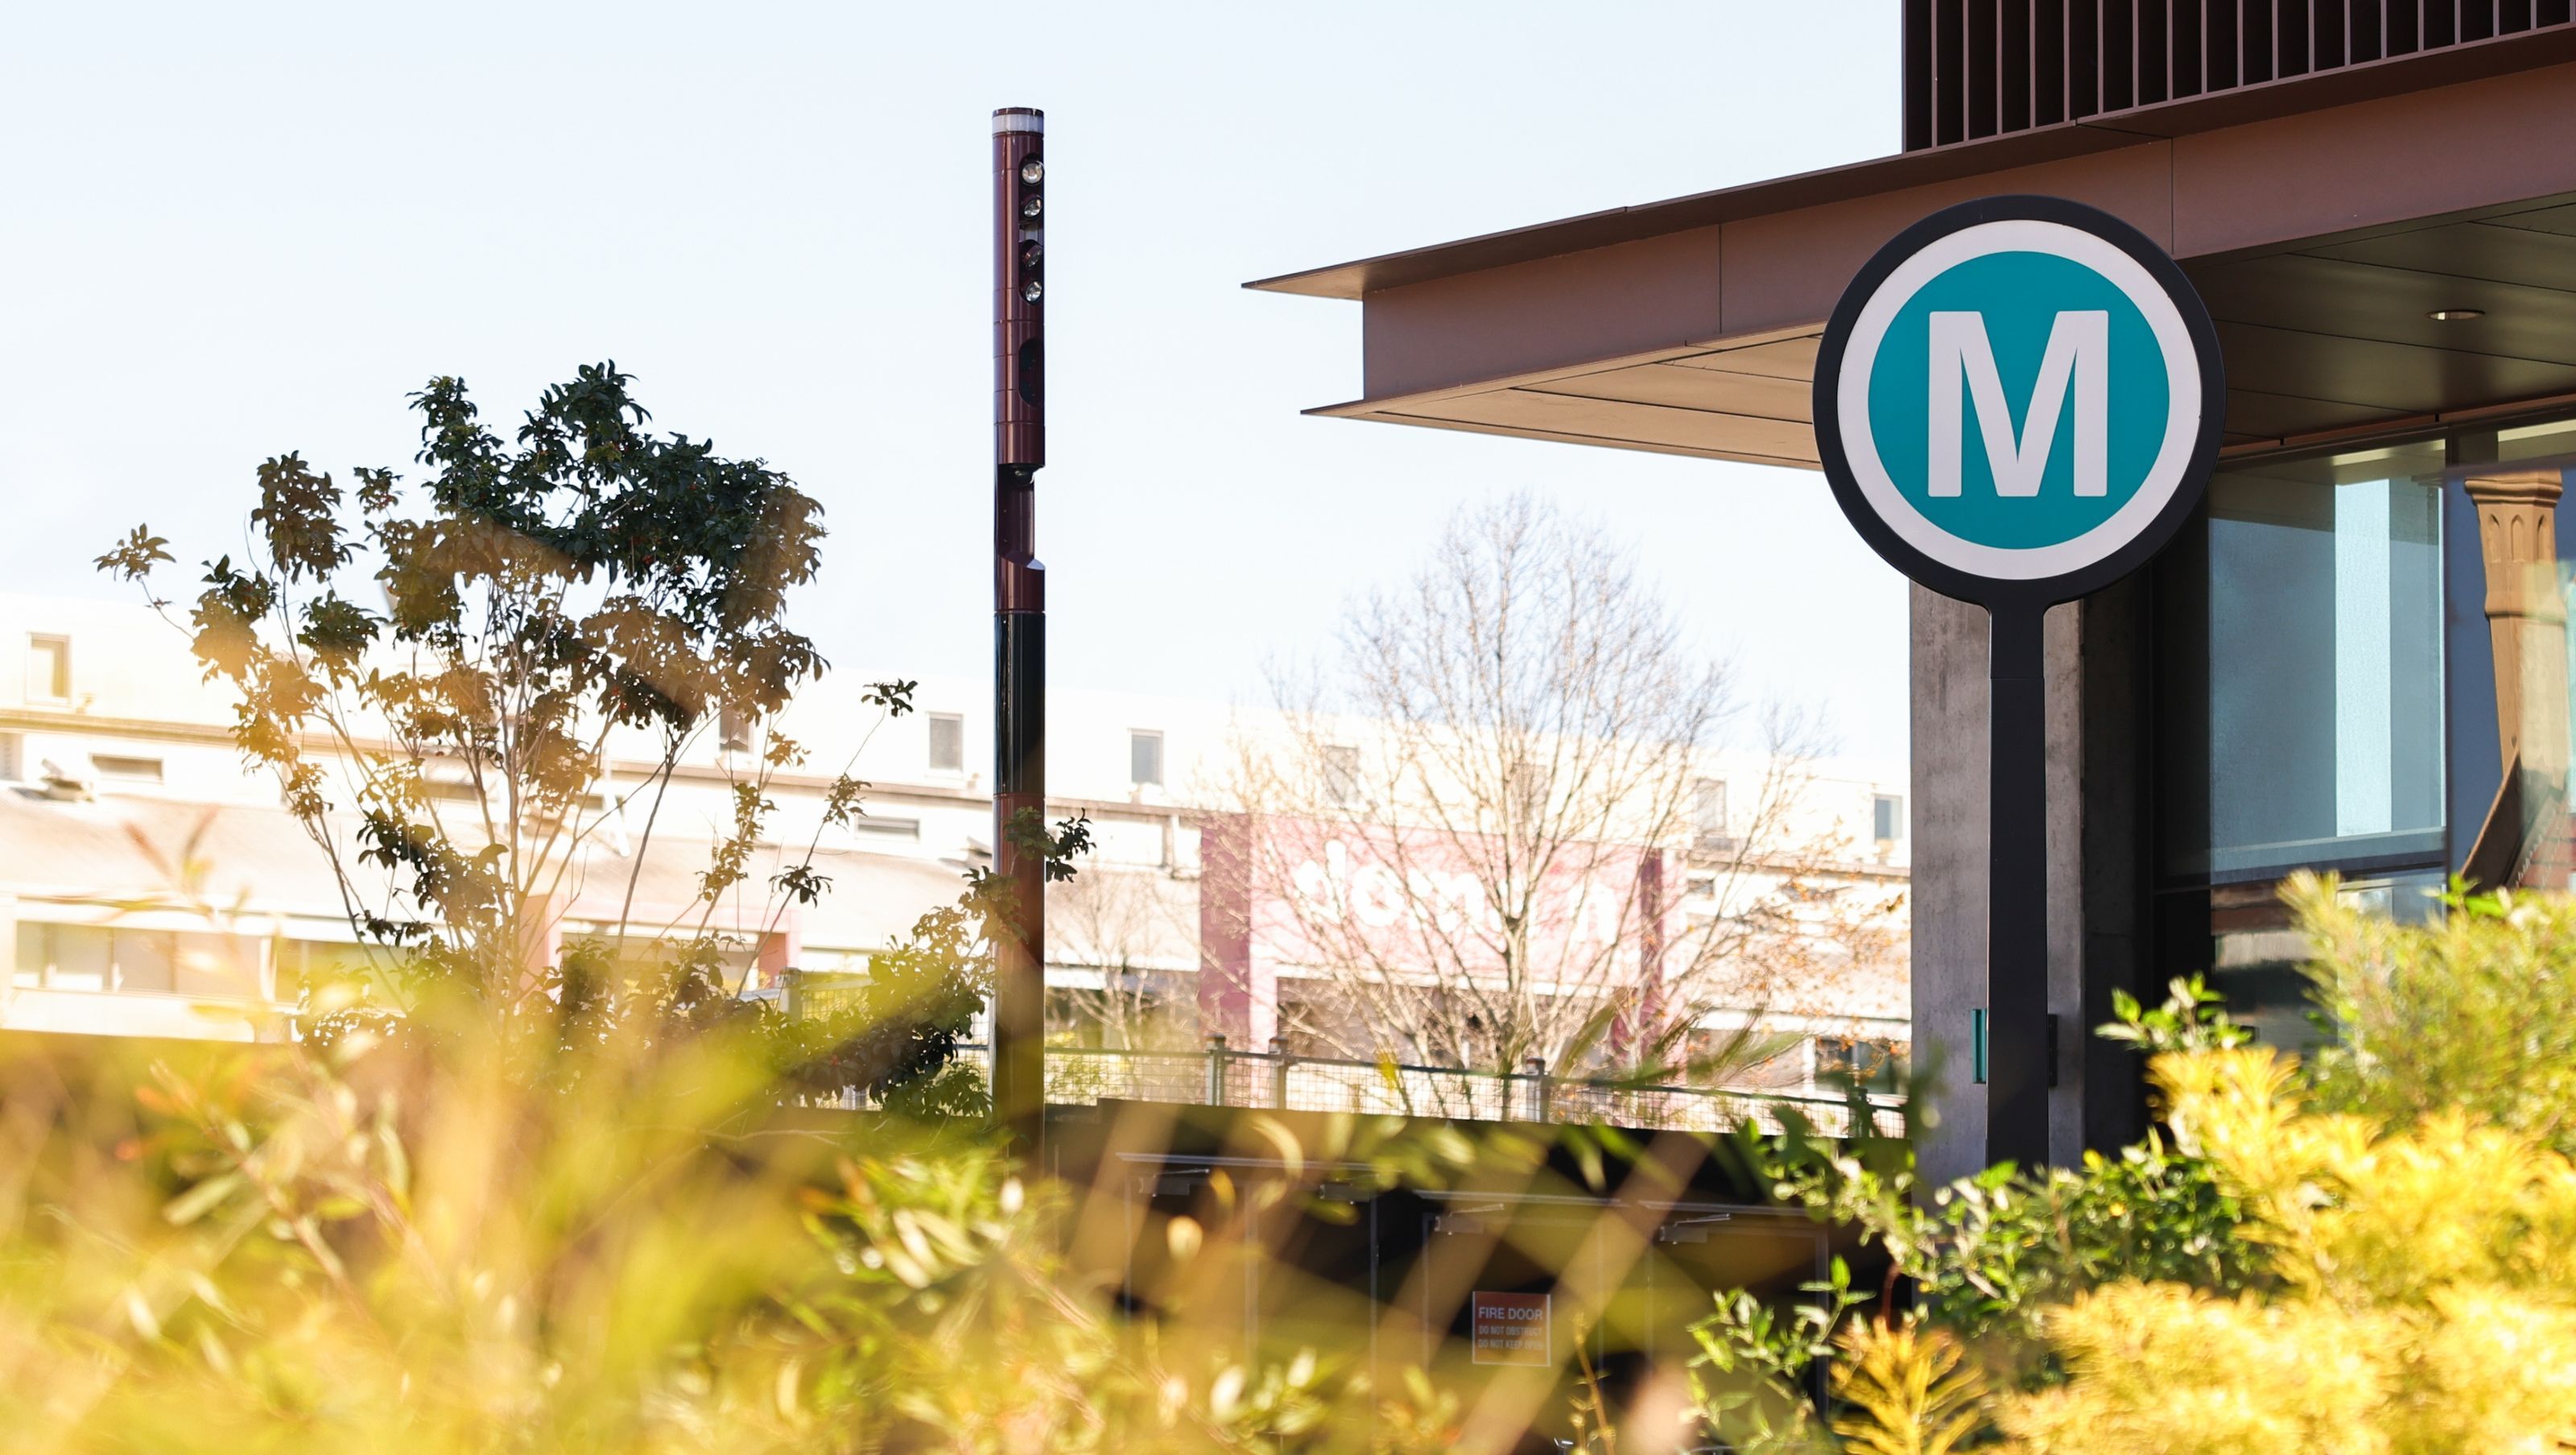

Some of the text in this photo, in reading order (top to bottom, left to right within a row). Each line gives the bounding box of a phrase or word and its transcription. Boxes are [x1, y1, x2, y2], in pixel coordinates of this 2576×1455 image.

[1928, 309, 2109, 498] M
[1294, 839, 1618, 945] domn
[1478, 1307, 1543, 1321] FIRE DOOR
[1479, 1325, 1489, 1334] DO
[1490, 1326, 1505, 1335] NOT
[1478, 1339, 1488, 1348] DO
[1489, 1339, 1504, 1349] NOT
